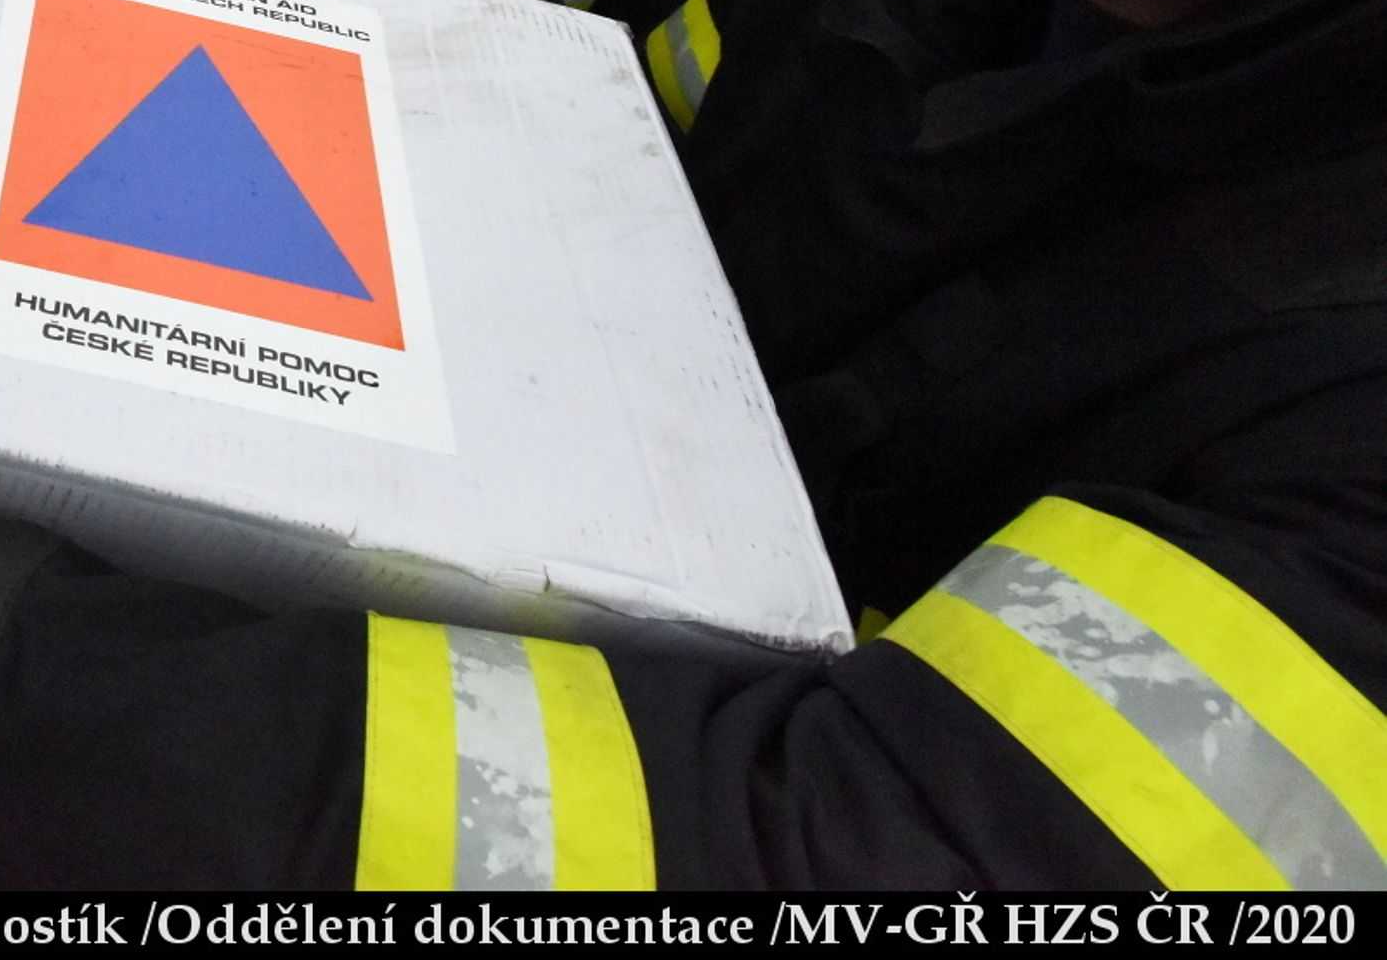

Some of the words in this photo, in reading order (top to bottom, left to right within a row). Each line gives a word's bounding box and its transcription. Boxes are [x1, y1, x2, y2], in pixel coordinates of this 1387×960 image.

[252, 6, 372, 42] REPUBLIC
[276, 0, 318, 16] AID
[14, 291, 247, 359] HUMANITÁRNÍ
[257, 345, 380, 389] POMOC
[42, 319, 156, 363] ČESKÉ
[165, 348, 352, 407] REPUBLIKY
